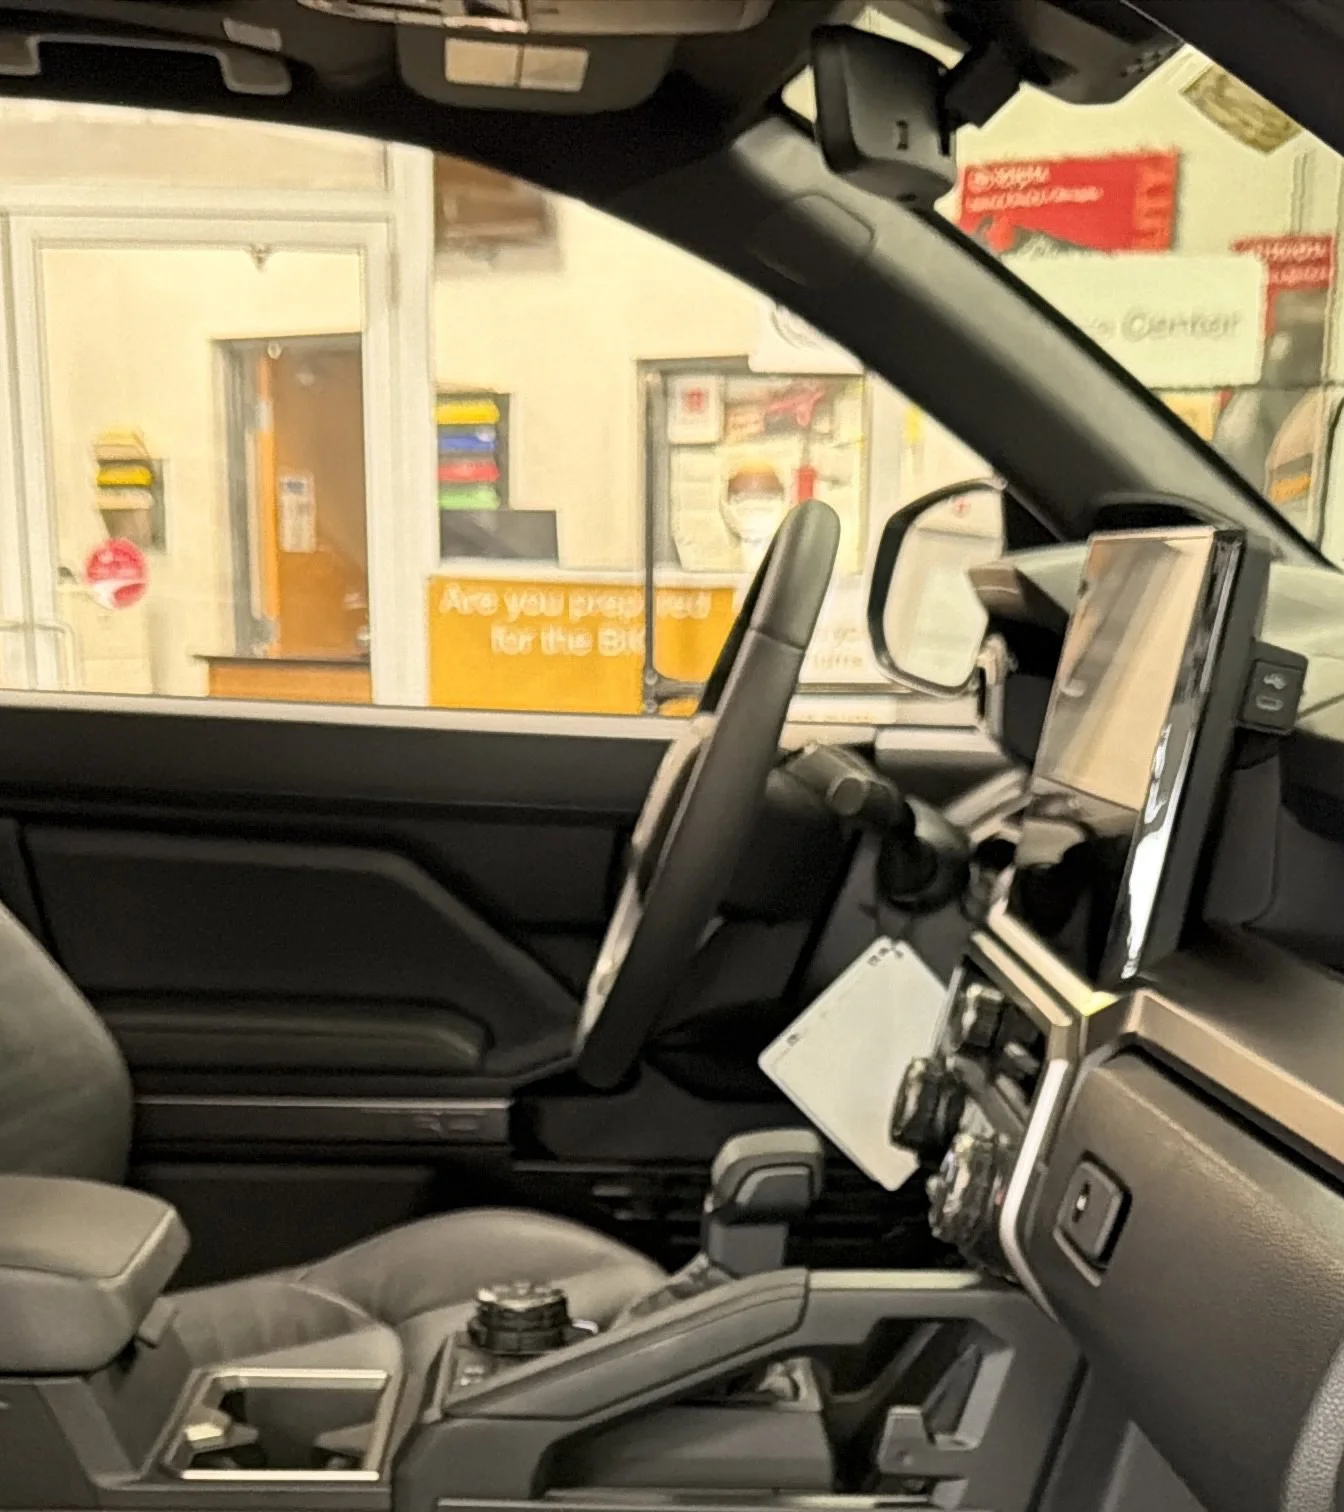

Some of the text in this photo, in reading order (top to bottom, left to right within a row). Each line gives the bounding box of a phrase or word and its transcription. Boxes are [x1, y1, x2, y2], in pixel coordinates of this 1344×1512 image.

[439, 582, 712, 624] Are you prepred
